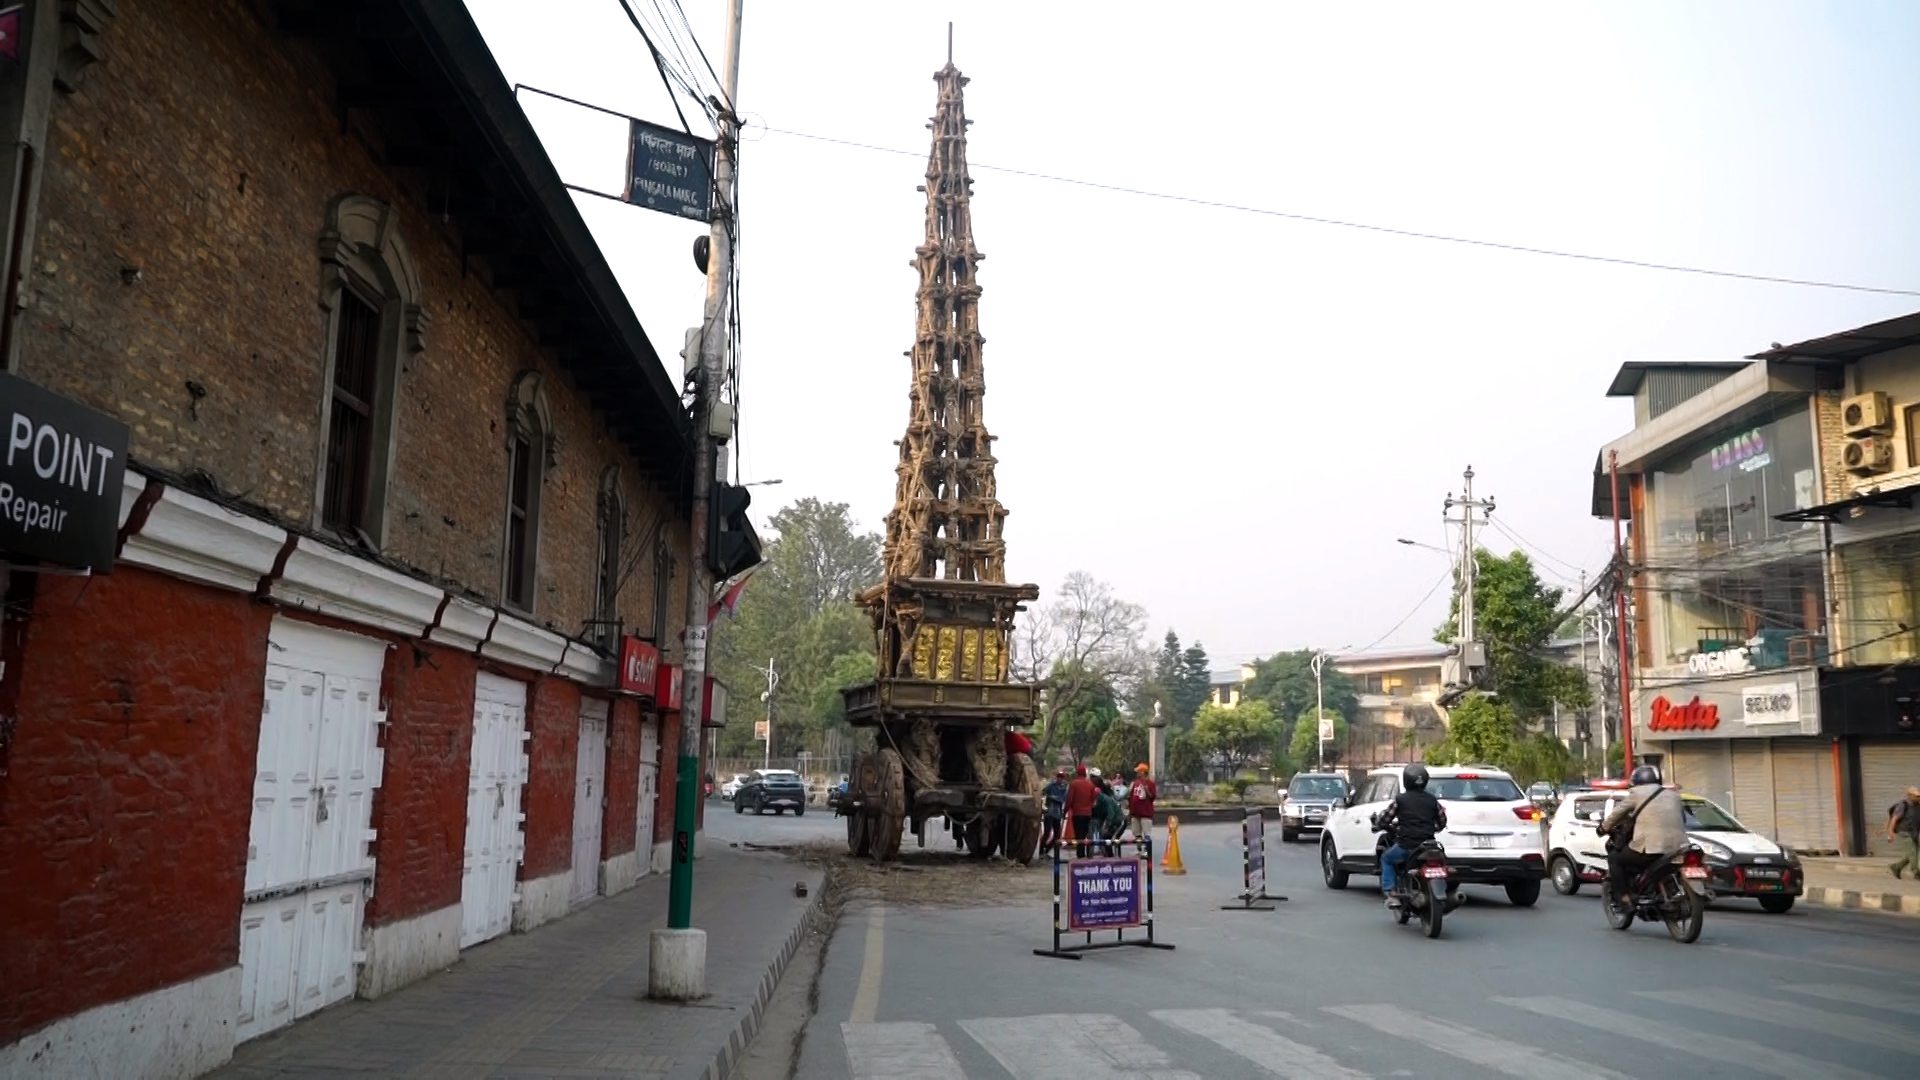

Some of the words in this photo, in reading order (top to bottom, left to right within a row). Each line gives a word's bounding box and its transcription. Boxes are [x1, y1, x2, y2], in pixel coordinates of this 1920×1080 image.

[8, 412, 114, 496] POINT
[0, 482, 67, 533] Repair
[1648, 694, 1720, 732] Bata
[1078, 880, 1110, 894] THANK
[1113, 878, 1132, 892] YOU
